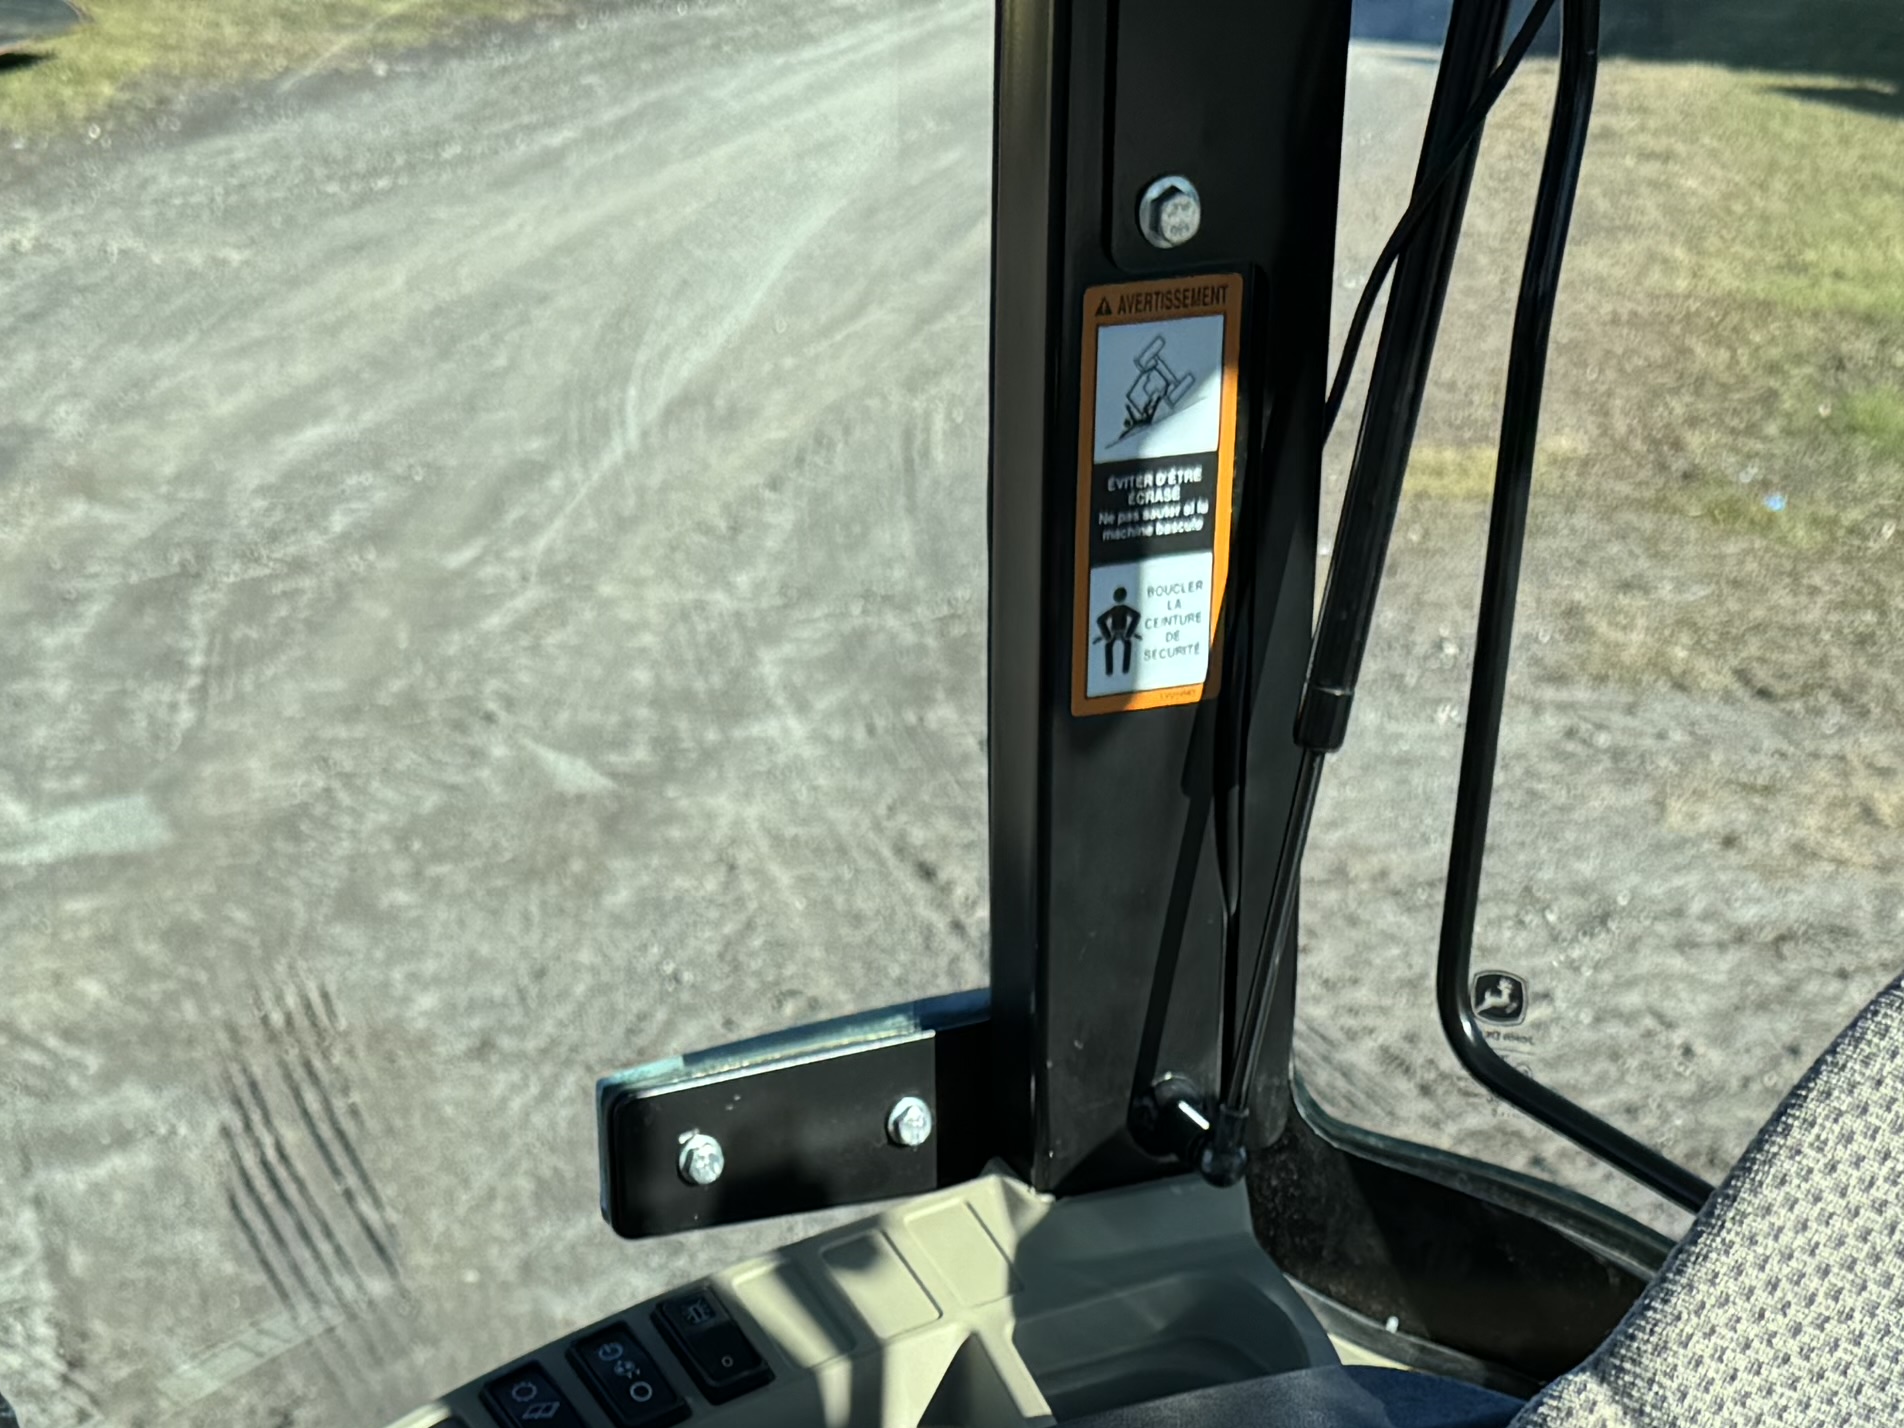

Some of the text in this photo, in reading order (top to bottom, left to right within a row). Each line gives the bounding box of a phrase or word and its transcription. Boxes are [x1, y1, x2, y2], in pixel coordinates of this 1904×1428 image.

[1118, 284, 1229, 315] AVERTISSEMENT
[1102, 520, 1154, 542] machine
[1147, 579, 1204, 598] BOUCLER
[1167, 598, 1182, 611] LA
[1144, 611, 1202, 630] CEINTURE
[1165, 630, 1180, 643] DE
